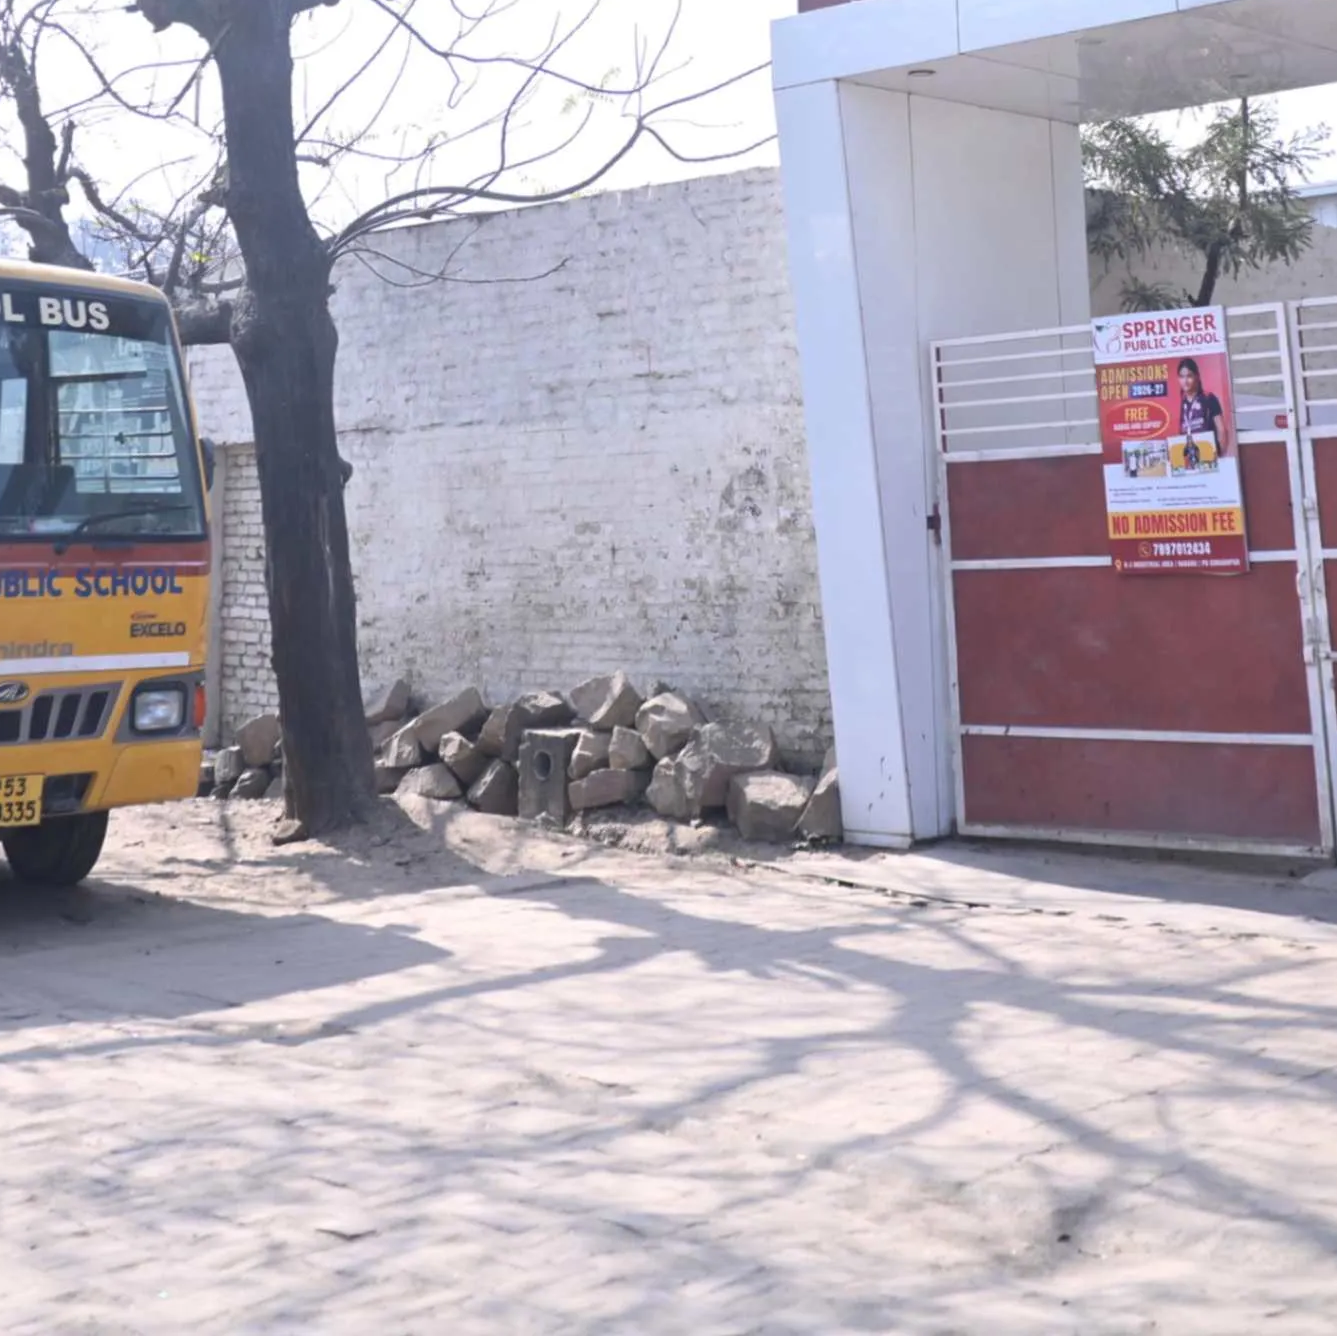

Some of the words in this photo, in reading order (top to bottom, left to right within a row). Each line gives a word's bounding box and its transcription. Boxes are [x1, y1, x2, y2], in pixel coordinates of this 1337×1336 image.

[38, 296, 110, 330] BUS
[1121, 313, 1217, 339] SPRINGER
[1124, 338, 1167, 352] PUBLIC
[1171, 332, 1221, 348] SCHOOL
[1100, 364, 1169, 384] ADMISSIONS
[1099, 384, 1129, 401] OPEN
[1112, 515, 1130, 535] NO
[1134, 512, 1208, 534] ADMISSION
[1212, 511, 1236, 532] FEE
[73, 564, 183, 598] SCHOOL
[129, 620, 187, 638] EXCELO
